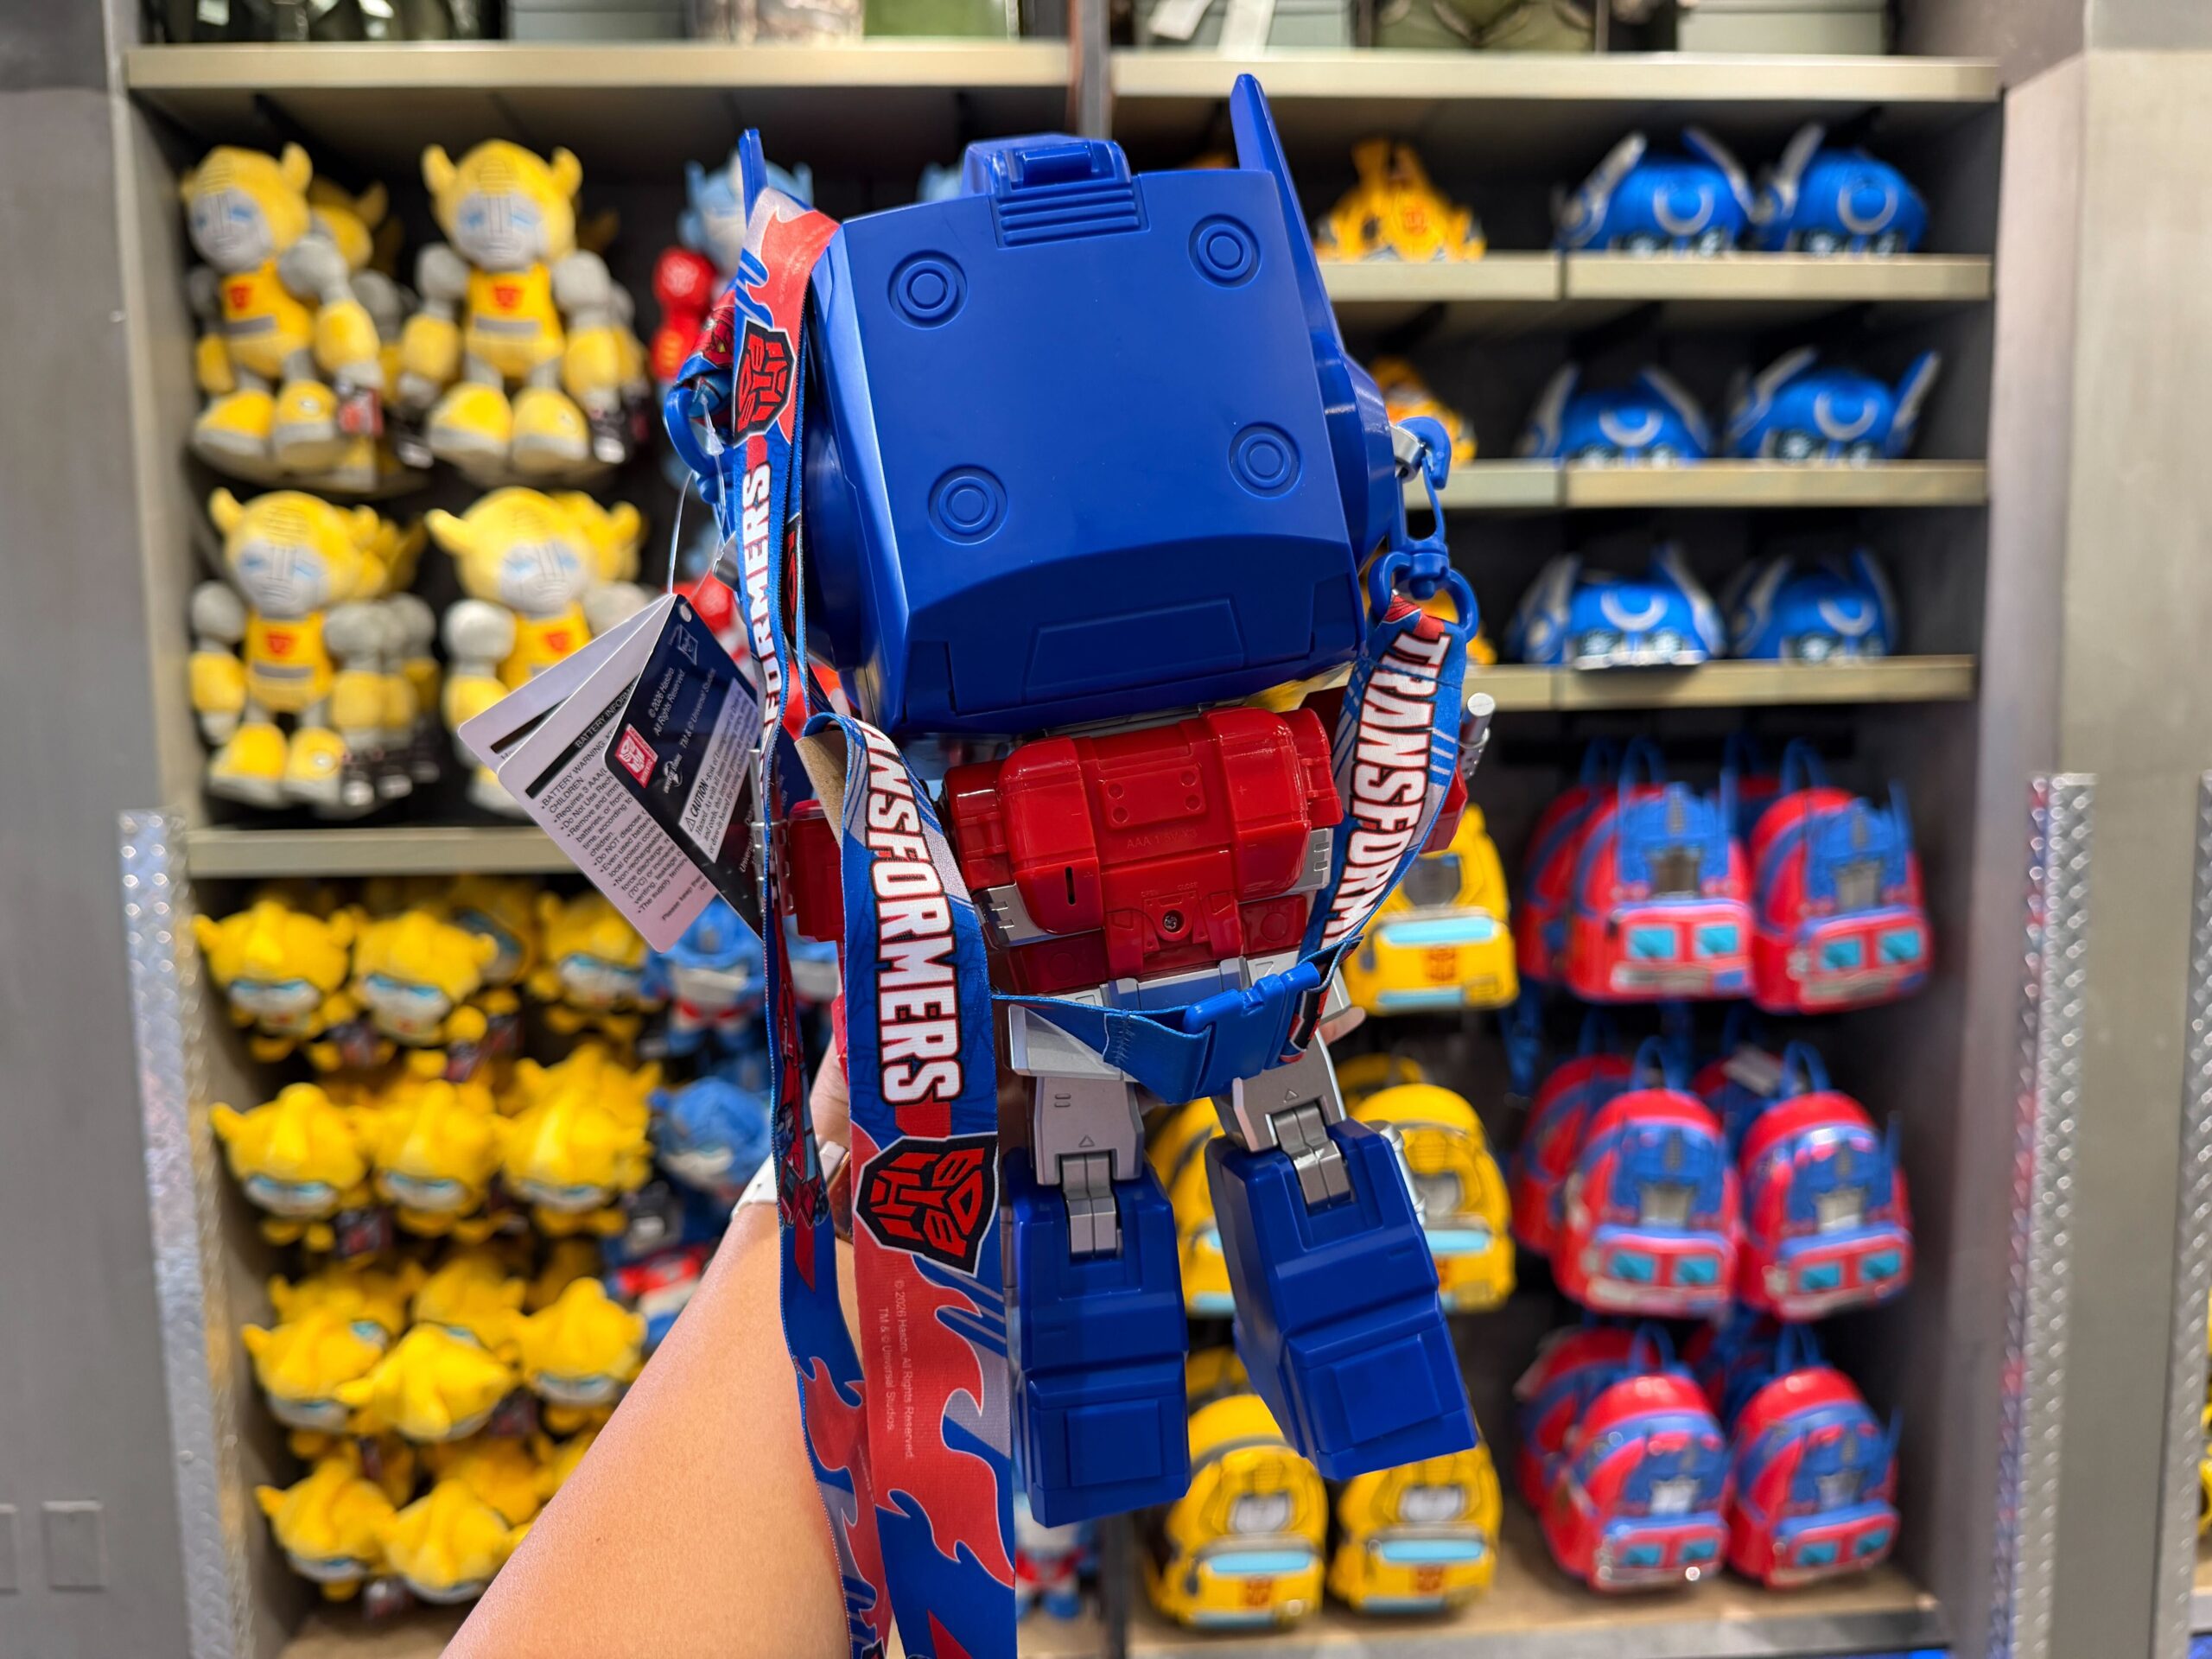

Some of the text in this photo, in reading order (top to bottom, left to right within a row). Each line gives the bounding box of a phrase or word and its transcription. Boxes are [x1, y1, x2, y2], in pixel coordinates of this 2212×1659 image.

[742, 461, 783, 773] FORMERS
[575, 683, 633, 748] BATTERY INFORM
[651, 689, 664, 712] 2026
[657, 700, 673, 728] Rights
[652, 721, 663, 737] All
[679, 734, 690, 750] TM
[541, 772, 574, 806] BATTERY
[548, 776, 584, 814] CHILDREN
[556, 791, 585, 821] Requires
[587, 766, 607, 788] AAA(L
[563, 773, 613, 828] Do Not Use Rech
[689, 777, 709, 818] CAUTION
[1321, 630, 1452, 950] TRANSFORM
[569, 807, 596, 836] Remove
[594, 795, 607, 810] and
[575, 791, 625, 843] batteries, or from
[582, 795, 632, 850] time, according to
[595, 851, 607, 864] Do
[604, 836, 620, 854] NOT
[618, 812, 644, 839] dispose
[601, 816, 652, 871] Even used batteri
[607, 823, 658, 877] local poison contr
[615, 830, 664, 884] Non-rechargeable
[1127, 836, 1152, 849] AAA
[645, 869, 654, 878] or
[651, 843, 677, 870] incinerat
[654, 855, 678, 880] leakage
[621, 874, 638, 891] force
[639, 856, 689, 912] The supply termin
[859, 719, 963, 1104] ANSFORMERS
[879, 1308, 889, 1322] TM
[895, 1292, 906, 1317] 2026
[882, 1345, 893, 1388] Universal
[902, 1357, 912, 1369] All
[902, 1371, 913, 1402] Rights
